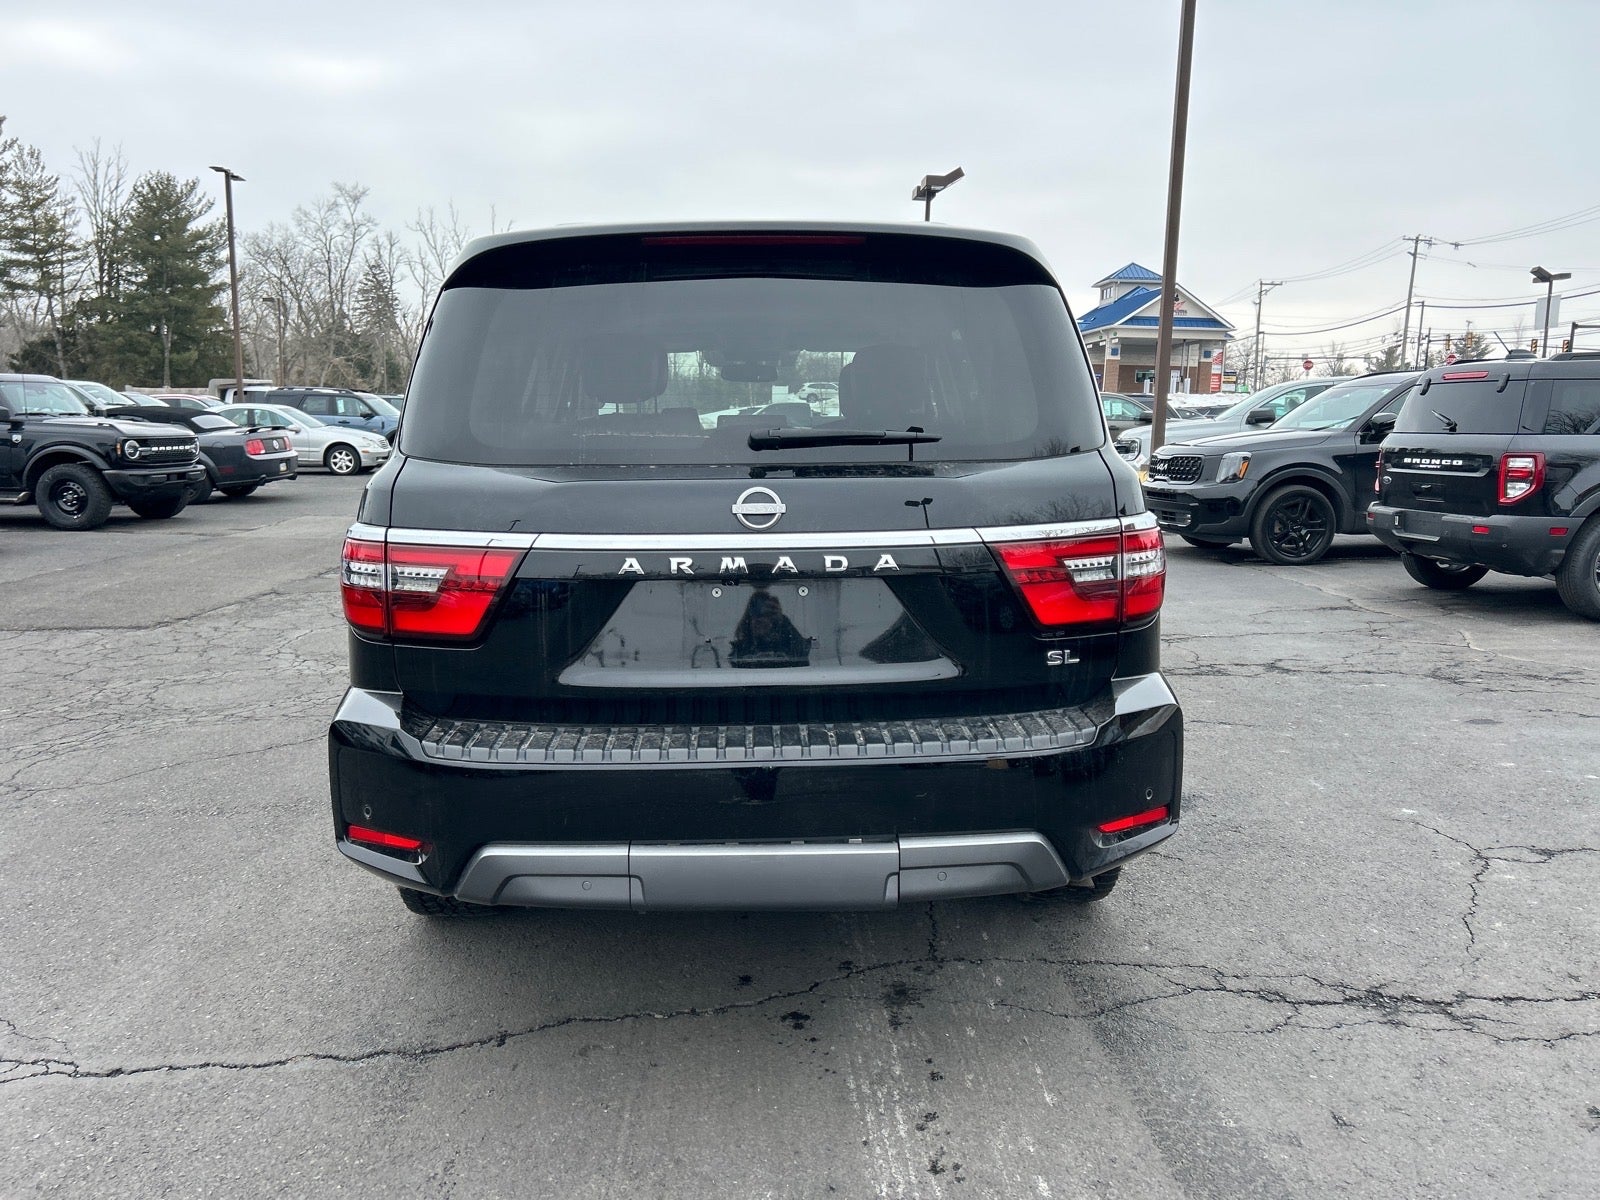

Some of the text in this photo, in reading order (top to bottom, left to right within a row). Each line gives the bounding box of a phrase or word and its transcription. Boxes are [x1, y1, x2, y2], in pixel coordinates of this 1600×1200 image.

[732, 504, 786, 514] NISSAN
[618, 554, 900, 575] ARMADA
[1047, 650, 1080, 666] SL
